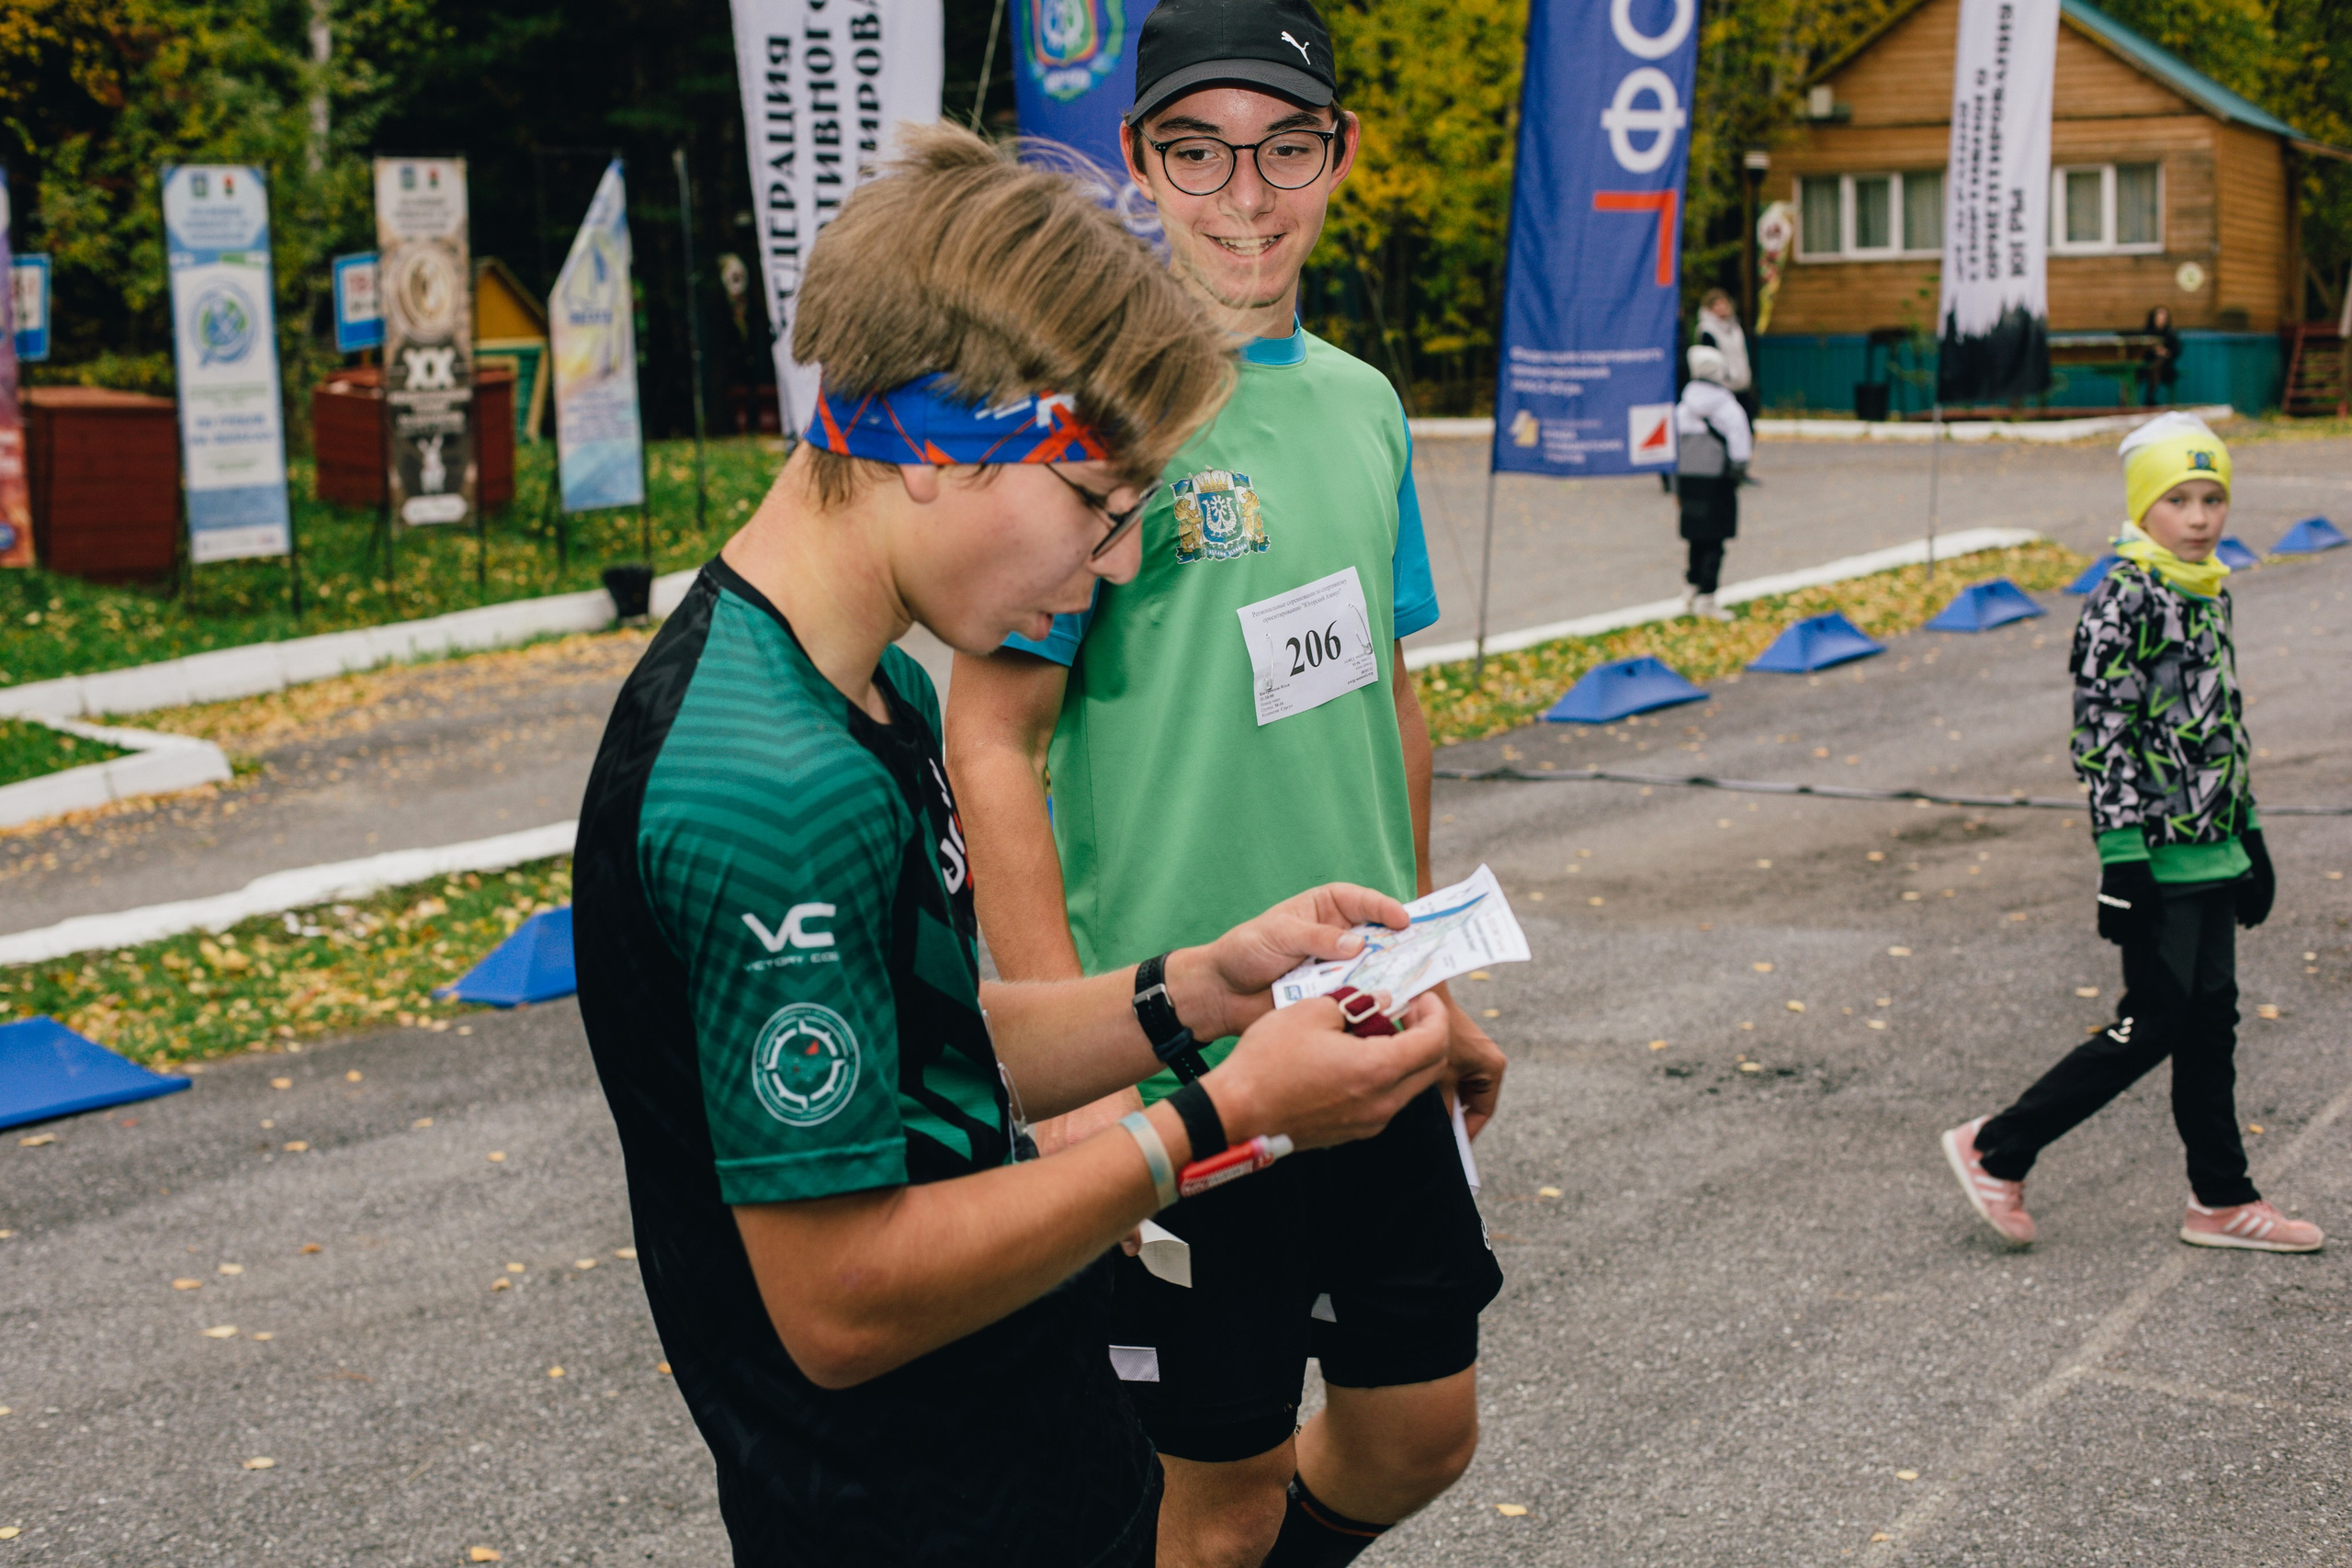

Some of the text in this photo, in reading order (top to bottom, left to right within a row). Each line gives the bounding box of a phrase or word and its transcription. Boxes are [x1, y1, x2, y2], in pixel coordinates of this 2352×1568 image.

[765, 34, 805, 328] ЕДЕРАЦИЯ
[805, 0, 845, 232] ТИВНОГ
[1285, 620, 1341, 677] 206
[741, 902, 837, 953] VC
